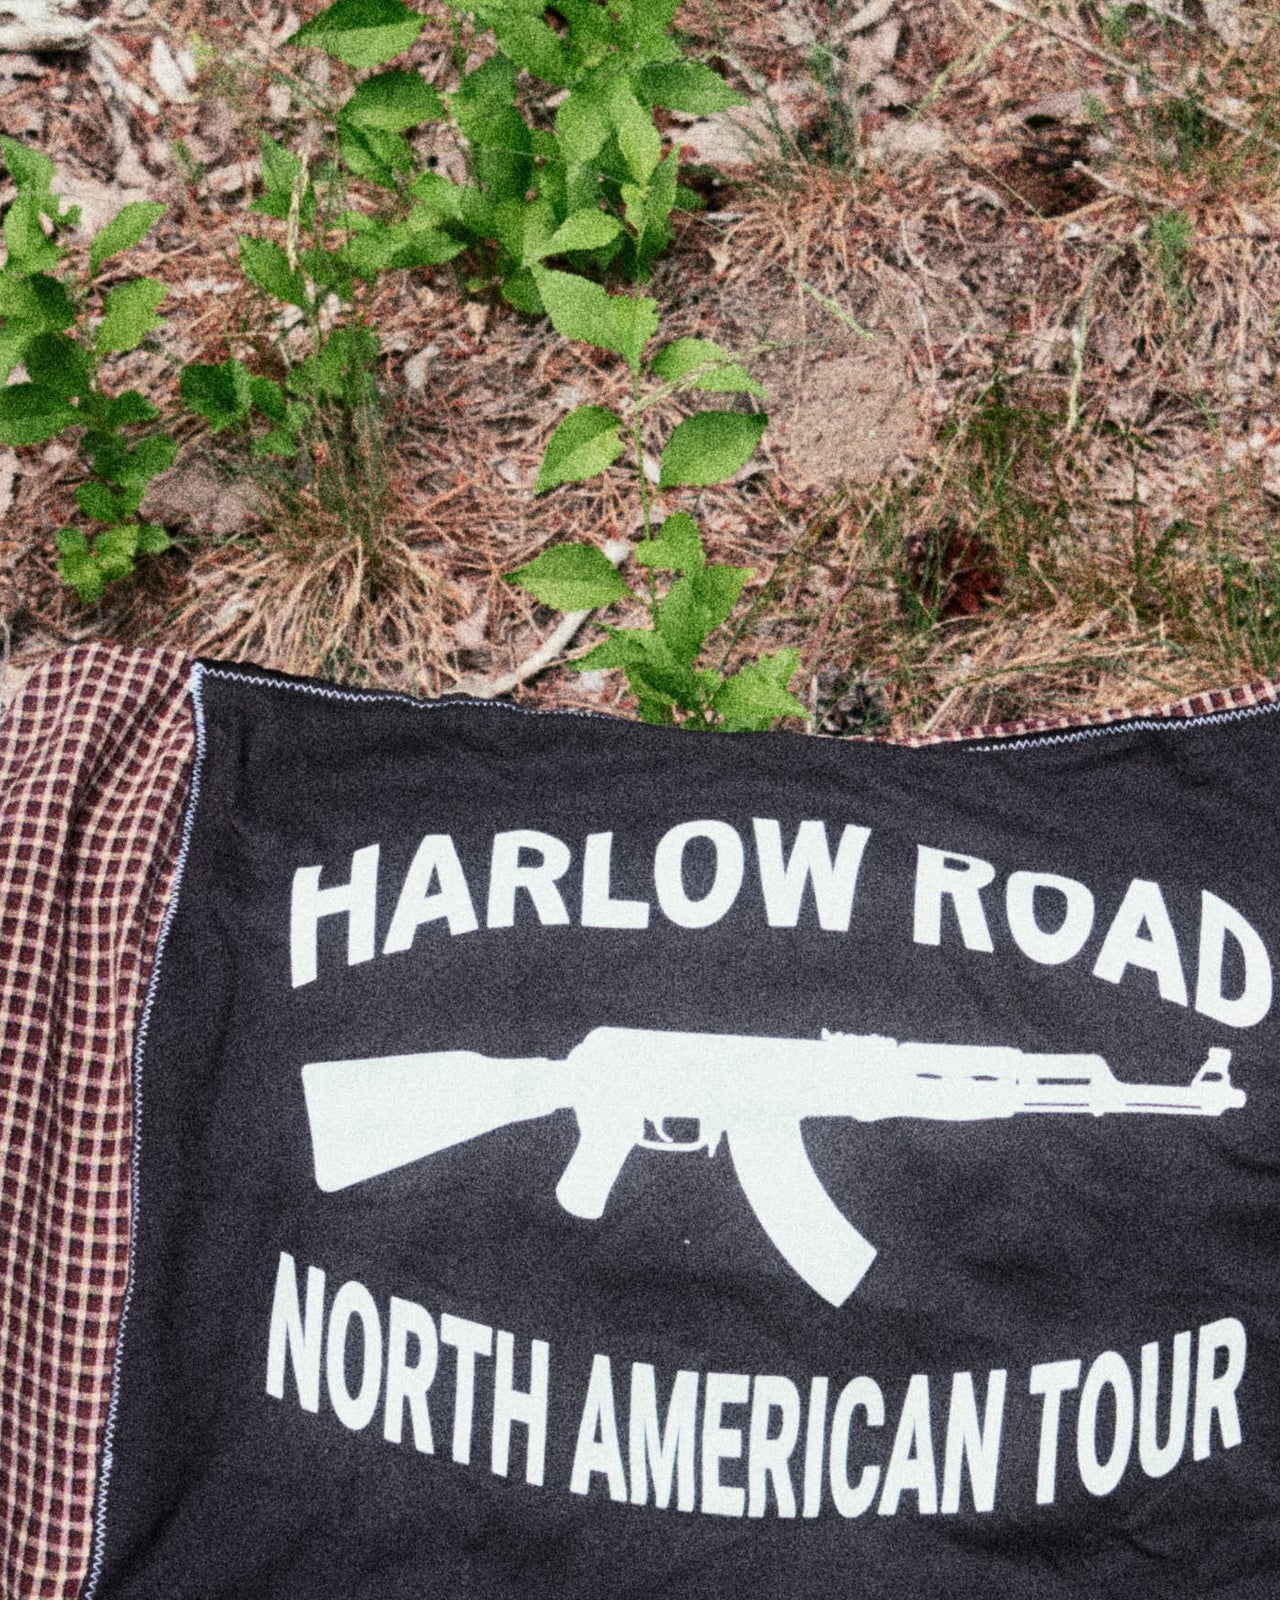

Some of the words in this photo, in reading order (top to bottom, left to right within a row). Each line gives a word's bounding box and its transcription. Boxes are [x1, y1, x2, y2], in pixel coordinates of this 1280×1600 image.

[290, 818, 871, 988] HARLOW
[913, 845, 1272, 1028] ROAD
[265, 1252, 549, 1486] NORTH
[570, 1354, 1007, 1518] AMERICAN
[1030, 1318, 1246, 1504] TOUR
